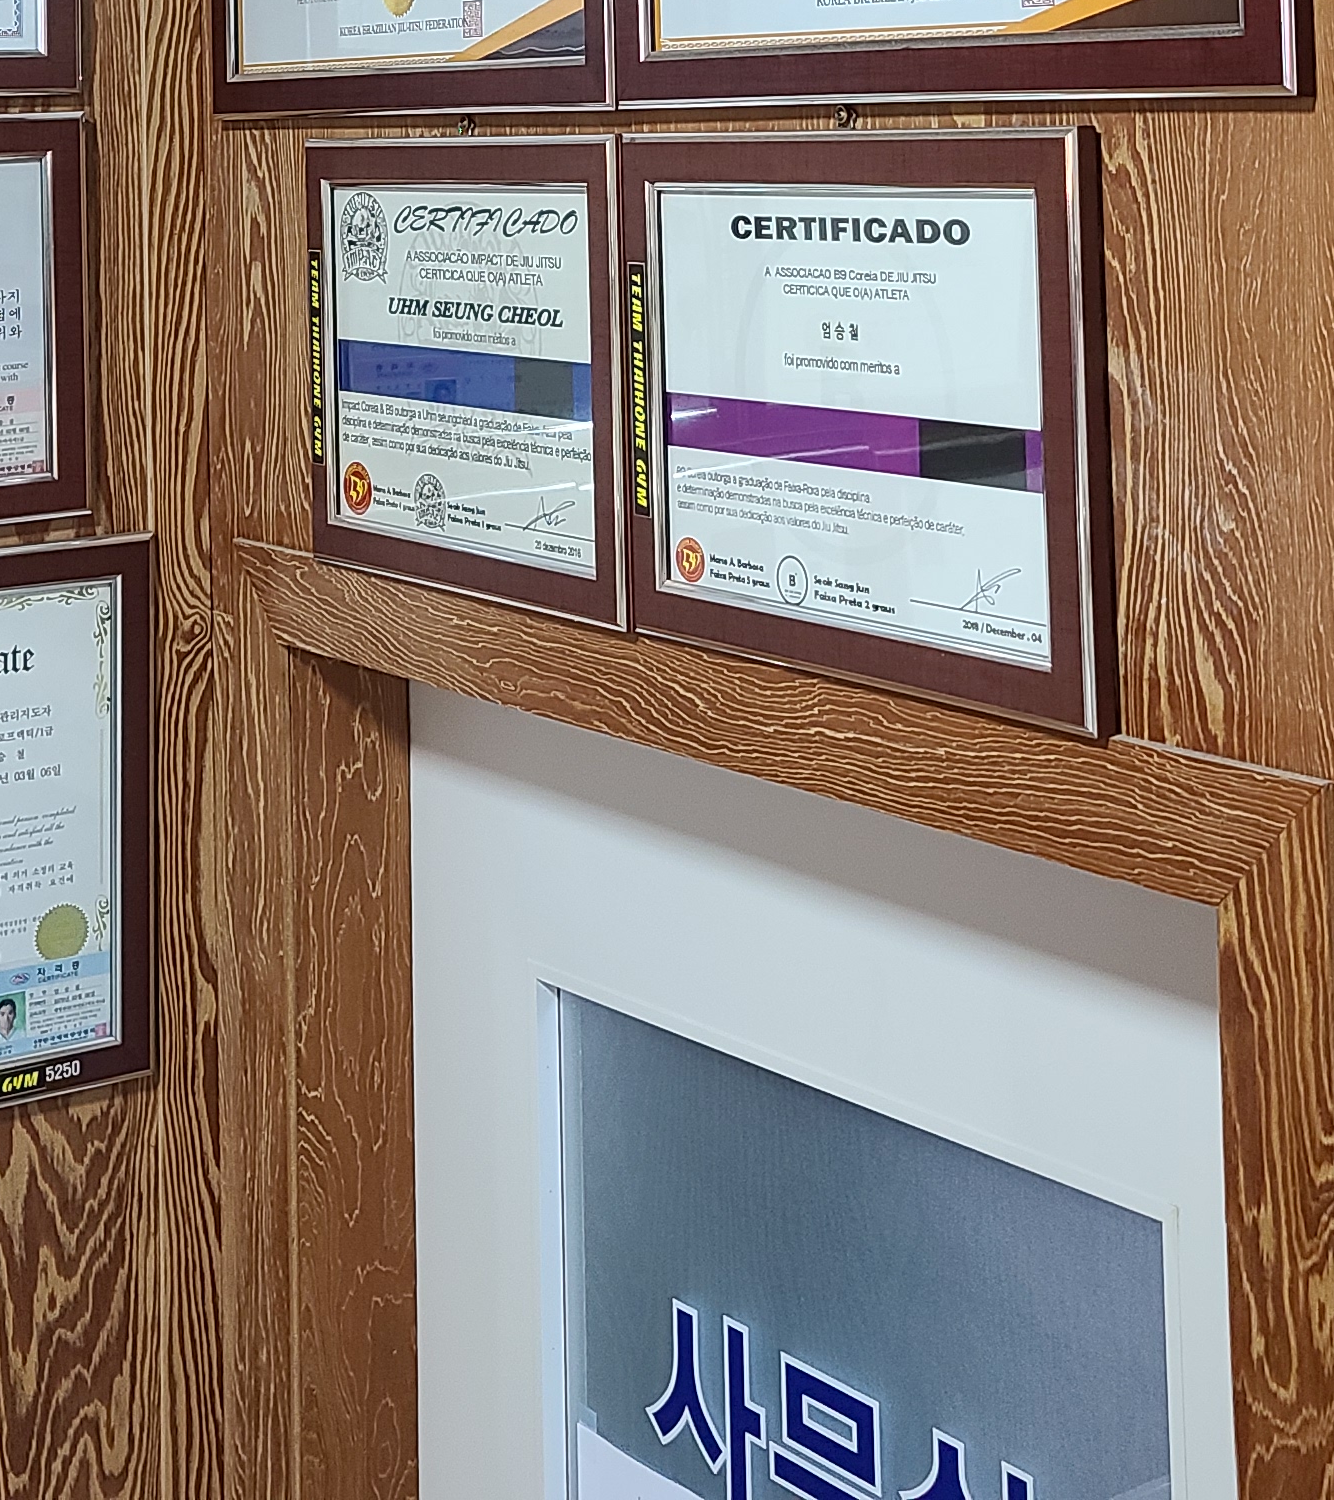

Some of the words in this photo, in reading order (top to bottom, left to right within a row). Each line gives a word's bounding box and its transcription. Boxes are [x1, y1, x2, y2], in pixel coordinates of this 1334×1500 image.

[393, 205, 578, 238] CERTIFICADO
[730, 214, 970, 246] CERTIFICADO
[310, 259, 319, 308] TEAM
[631, 274, 642, 331] TEAM
[388, 296, 430, 316] UHM
[497, 305, 563, 328] CHEOL
[311, 316, 321, 408] THAIHONE
[632, 341, 646, 450] THAIHONE
[313, 415, 322, 456] GYM
[635, 458, 647, 507] GYM
[1, 1071, 38, 1092] GYM
[45, 1060, 81, 1083] 5250
